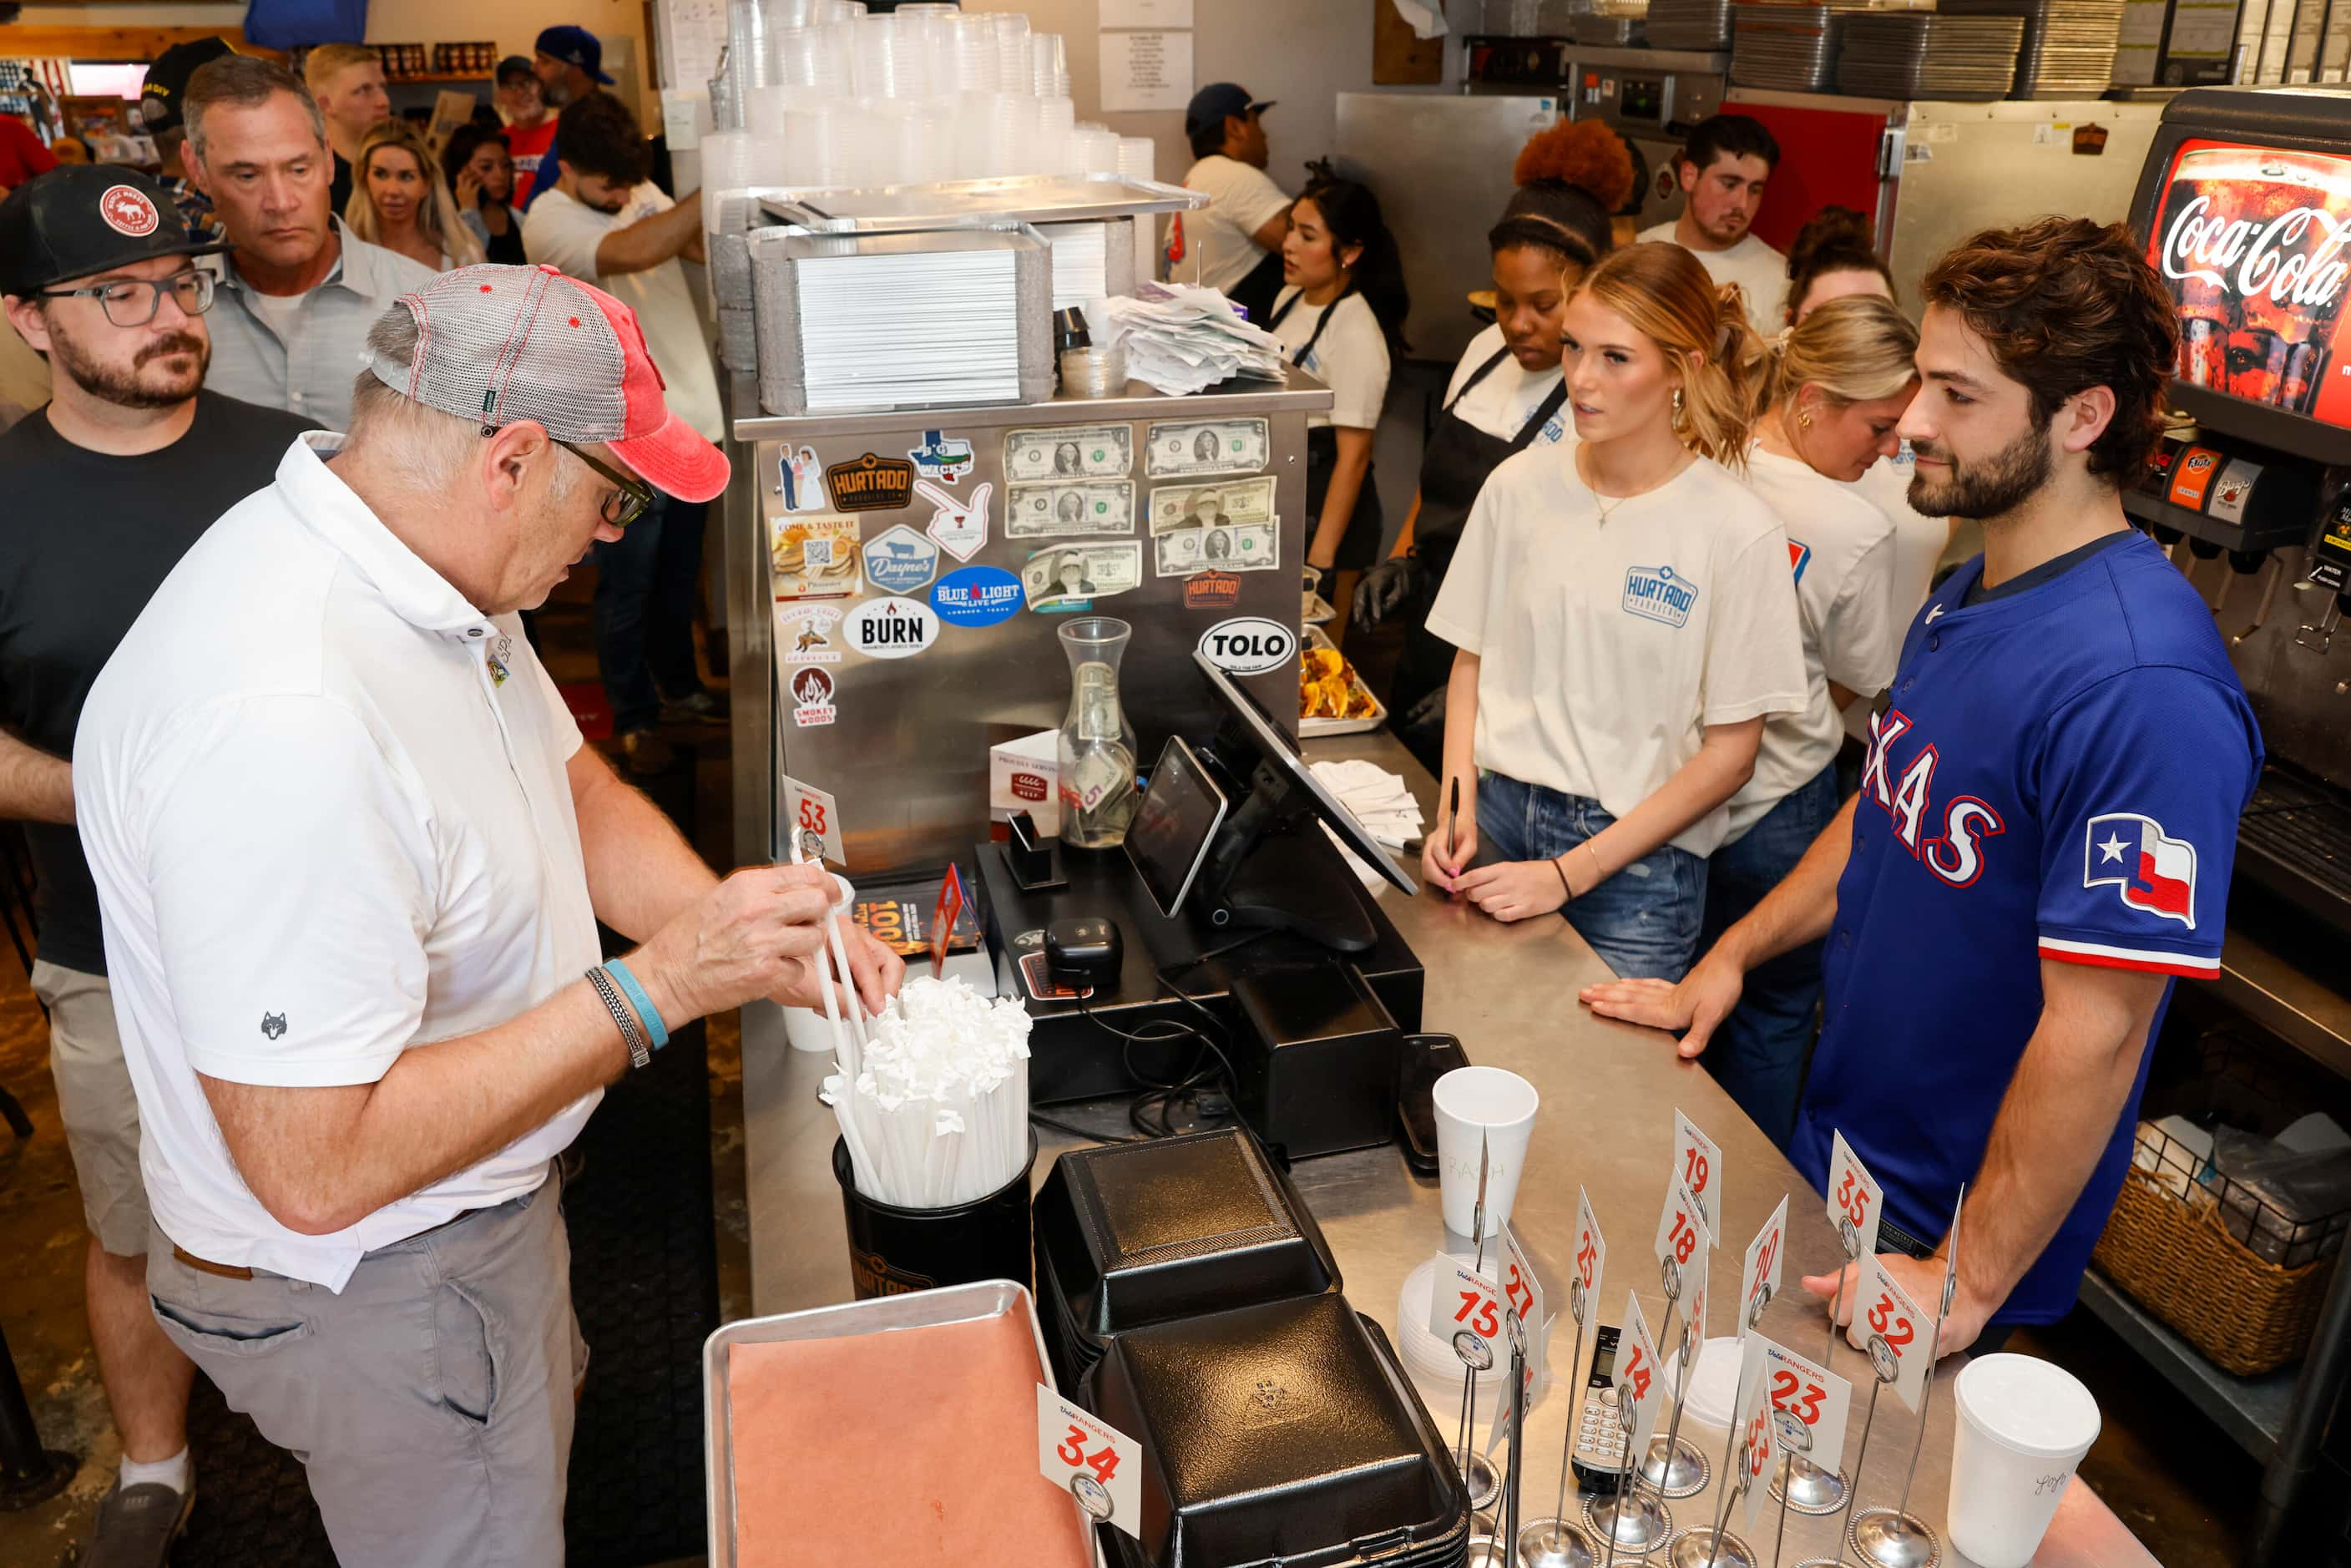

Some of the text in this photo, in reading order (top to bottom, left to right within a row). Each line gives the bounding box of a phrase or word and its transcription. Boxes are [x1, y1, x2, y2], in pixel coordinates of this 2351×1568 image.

[2162, 195, 2351, 307] Coca-Cola
[833, 470, 908, 494] HURTADO
[938, 584, 1020, 602] BLUE LIGHT
[1189, 580, 1237, 595] HURTADO
[1627, 575, 1692, 612] HURTADO
[862, 618, 923, 644] BURN
[1213, 635, 1285, 656] TOLO
[796, 708, 833, 716] SMOKEY
[1032, 762, 1057, 772] SERVIN
[799, 798, 827, 835] 53
[1685, 1147, 1709, 1193] 19
[1837, 1169, 1870, 1228] 35
[1577, 1230, 1597, 1290] 25
[1668, 1211, 1696, 1264] 18
[1750, 1228, 1779, 1301] 20
[1454, 1291, 1499, 1338] 15
[1505, 1263, 1534, 1323] 27
[1868, 1292, 1915, 1358] 32
[1624, 1343, 1651, 1403] 14
[1771, 1370, 1828, 1425] 23
[1057, 1424, 1121, 1486] 34
[1749, 1409, 1769, 1477] 33
